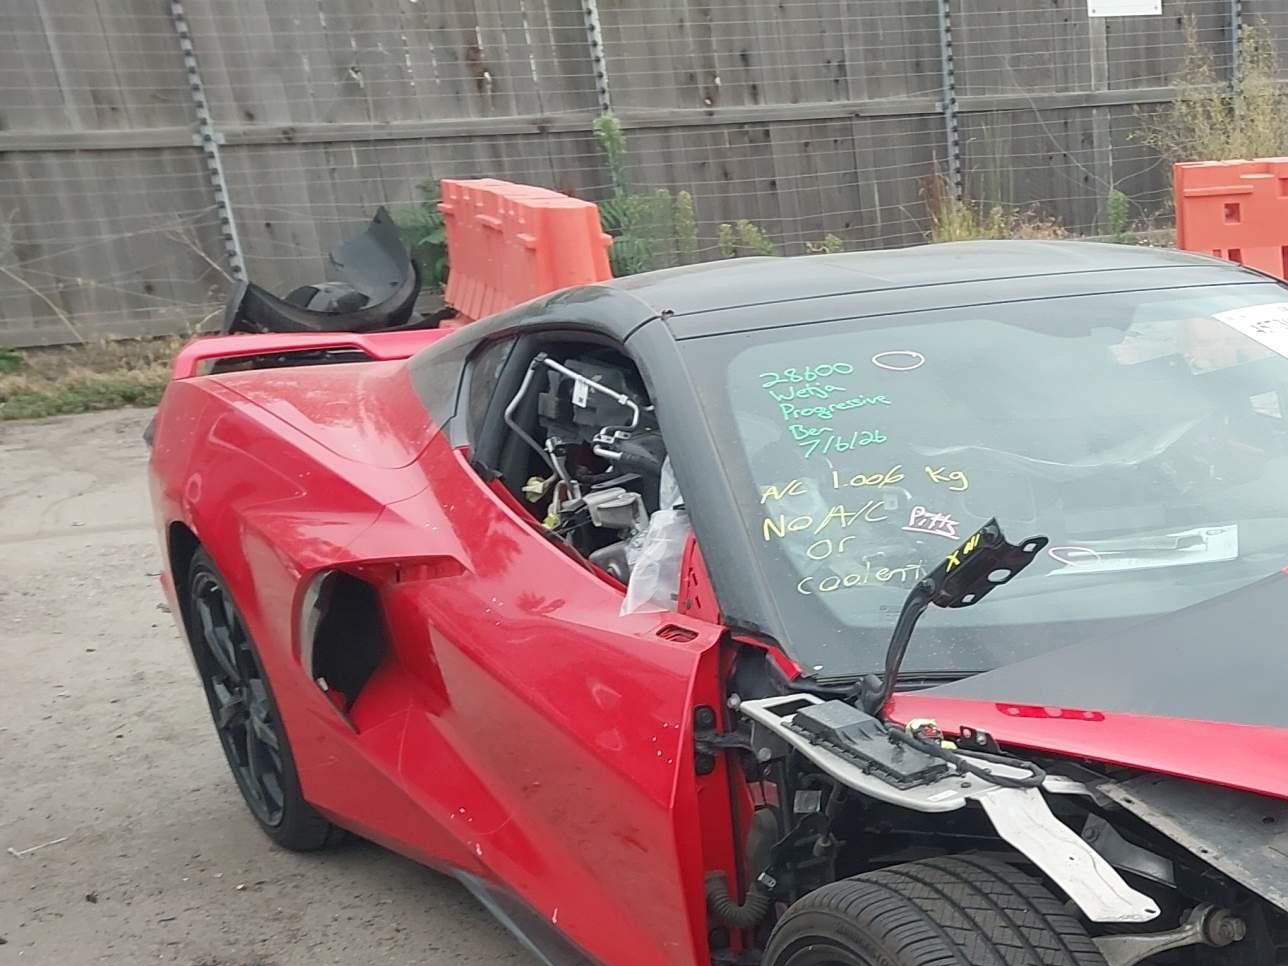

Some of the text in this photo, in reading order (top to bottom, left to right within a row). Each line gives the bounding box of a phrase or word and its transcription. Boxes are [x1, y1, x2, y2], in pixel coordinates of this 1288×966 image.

[759, 362, 854, 388] 28600
[780, 395, 892, 420] Progressive
[799, 430, 888, 458] 7/6/26
[760, 480, 808, 504] A/C
[832, 465, 905, 489] 1.006
[814, 500, 888, 535] A/C
